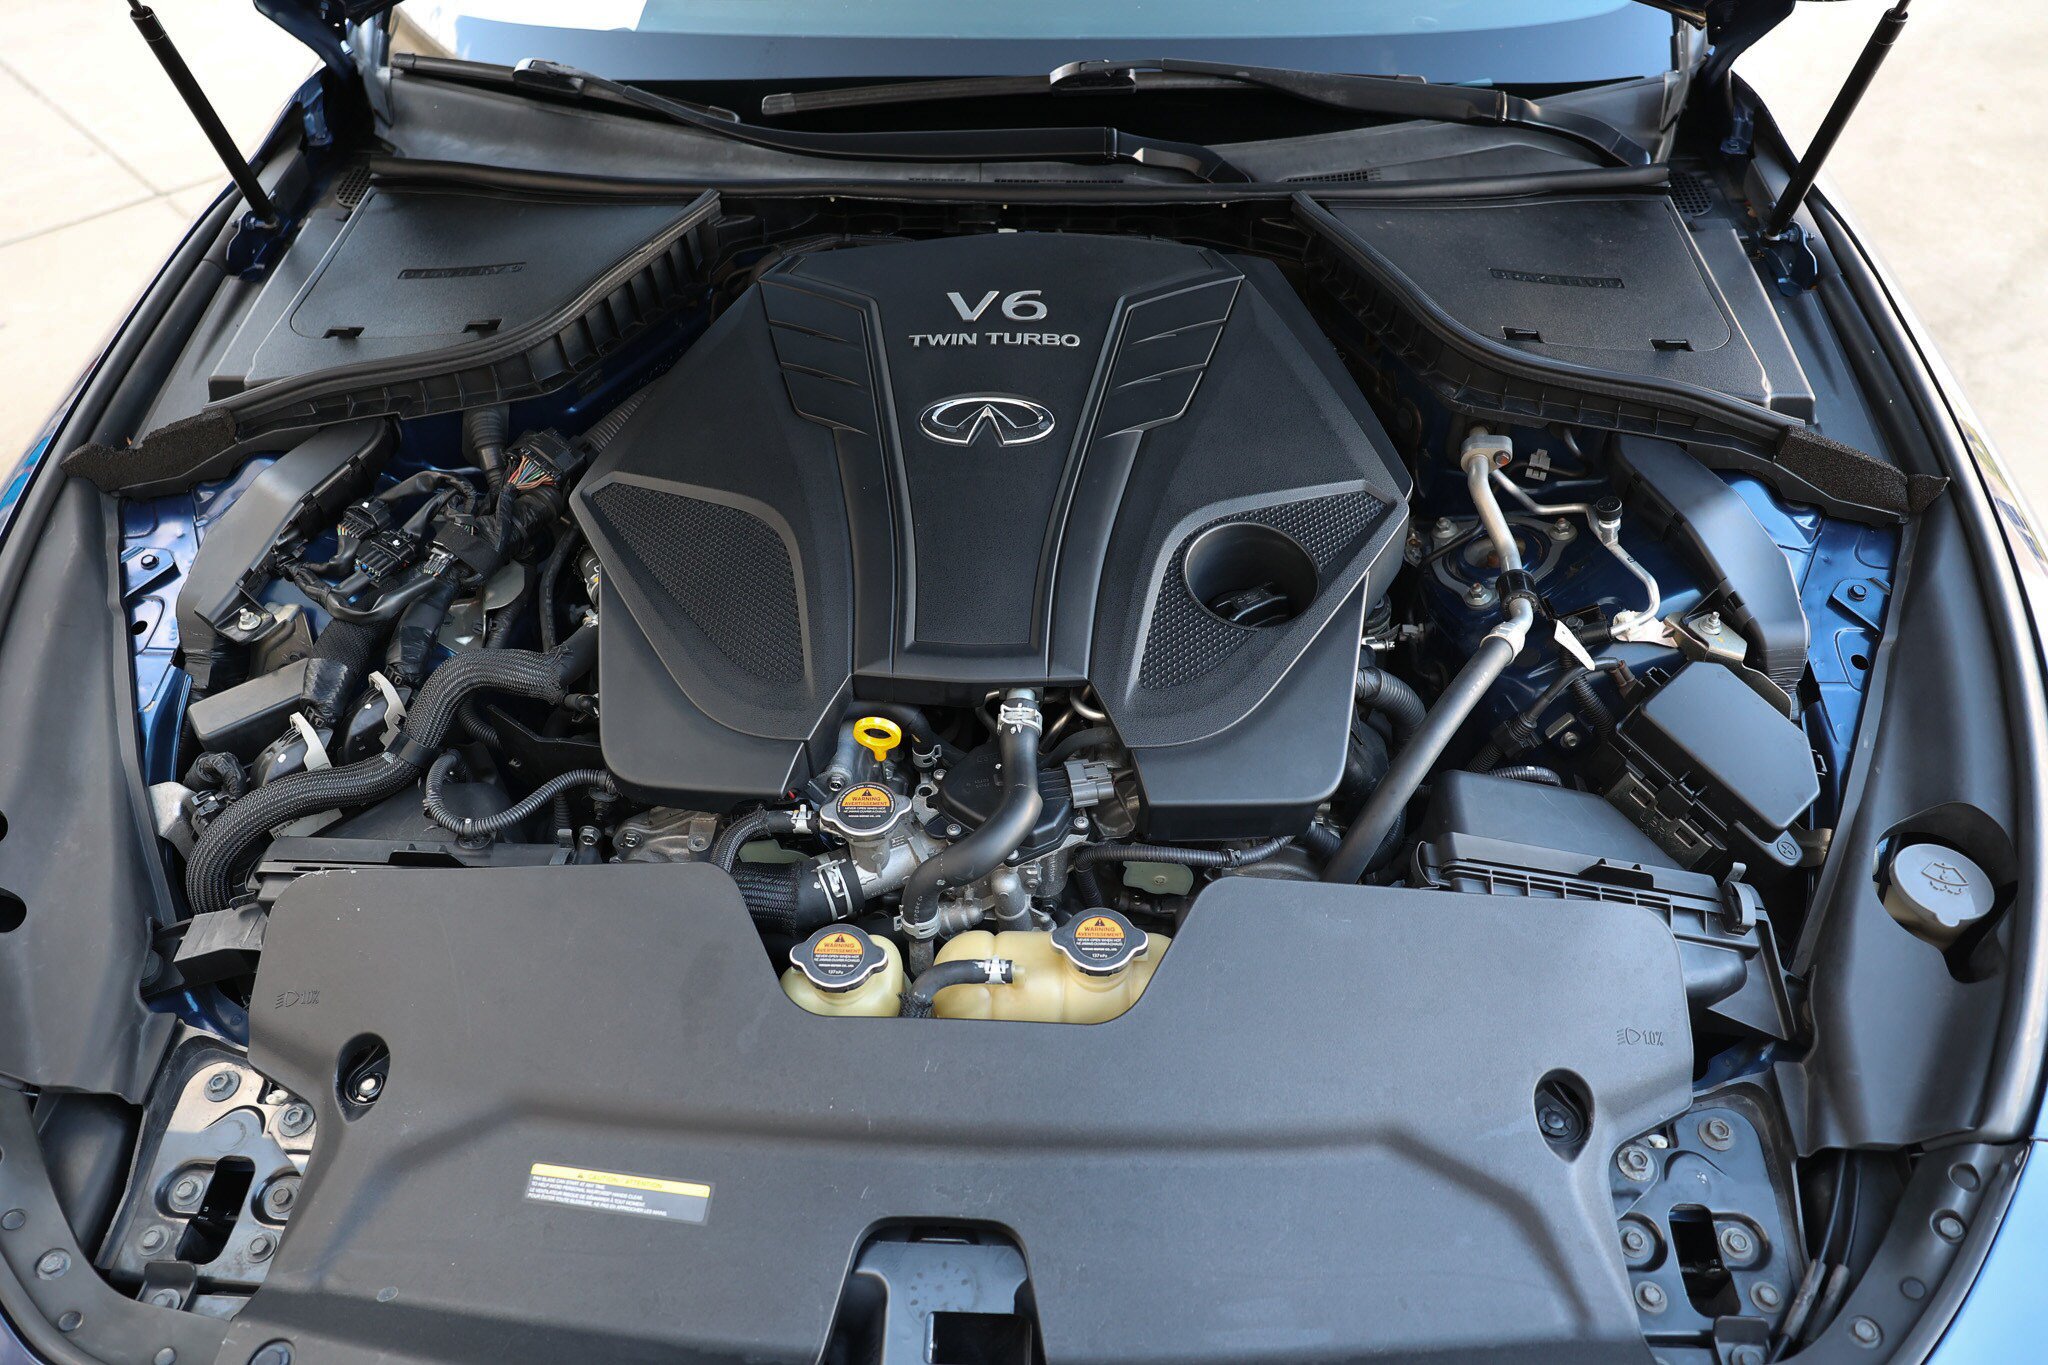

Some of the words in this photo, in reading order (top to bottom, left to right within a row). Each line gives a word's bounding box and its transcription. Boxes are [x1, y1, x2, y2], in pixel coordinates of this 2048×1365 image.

[946, 290, 1048, 322] V6
[909, 333, 977, 347] TWIN
[985, 332, 1081, 347] TURBO
